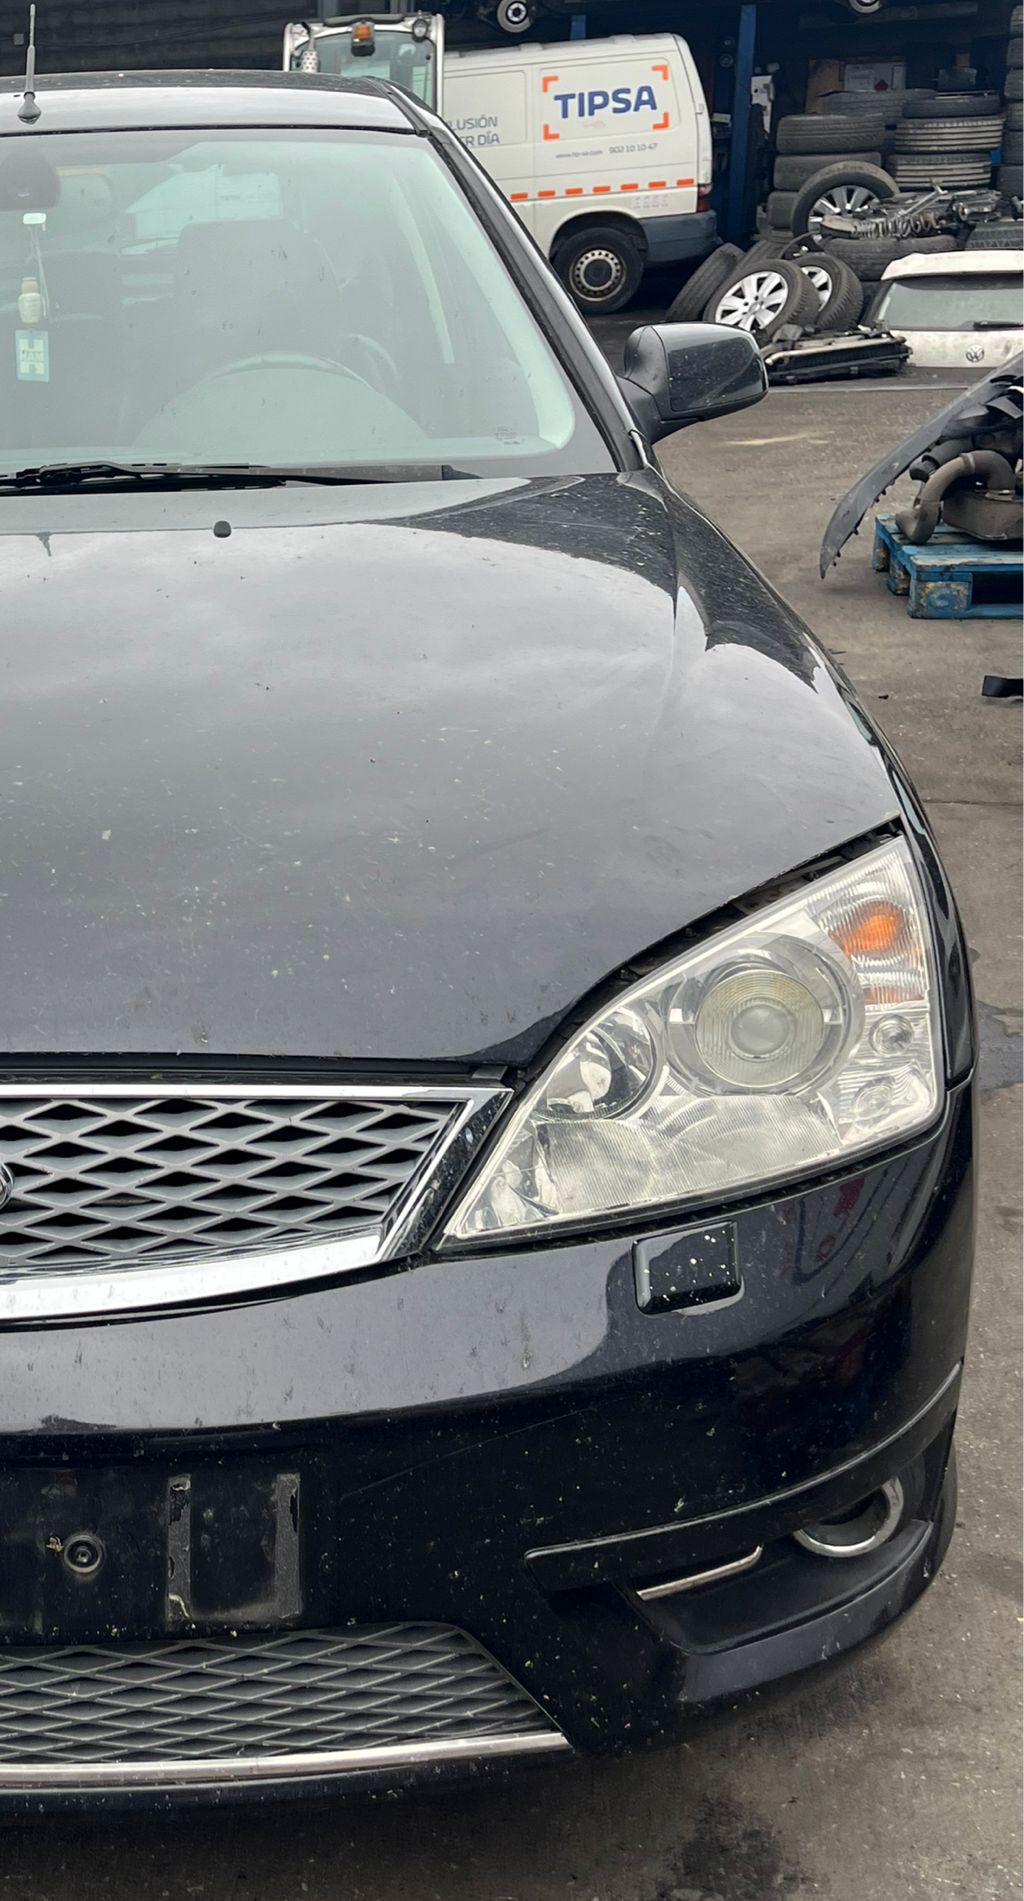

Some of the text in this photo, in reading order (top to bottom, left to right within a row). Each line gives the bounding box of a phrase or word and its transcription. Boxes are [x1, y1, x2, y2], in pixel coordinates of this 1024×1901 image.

[554, 85, 658, 119] TIPSA
[447, 114, 498, 130] LUSIÓN
[477, 131, 501, 145] DÍA
